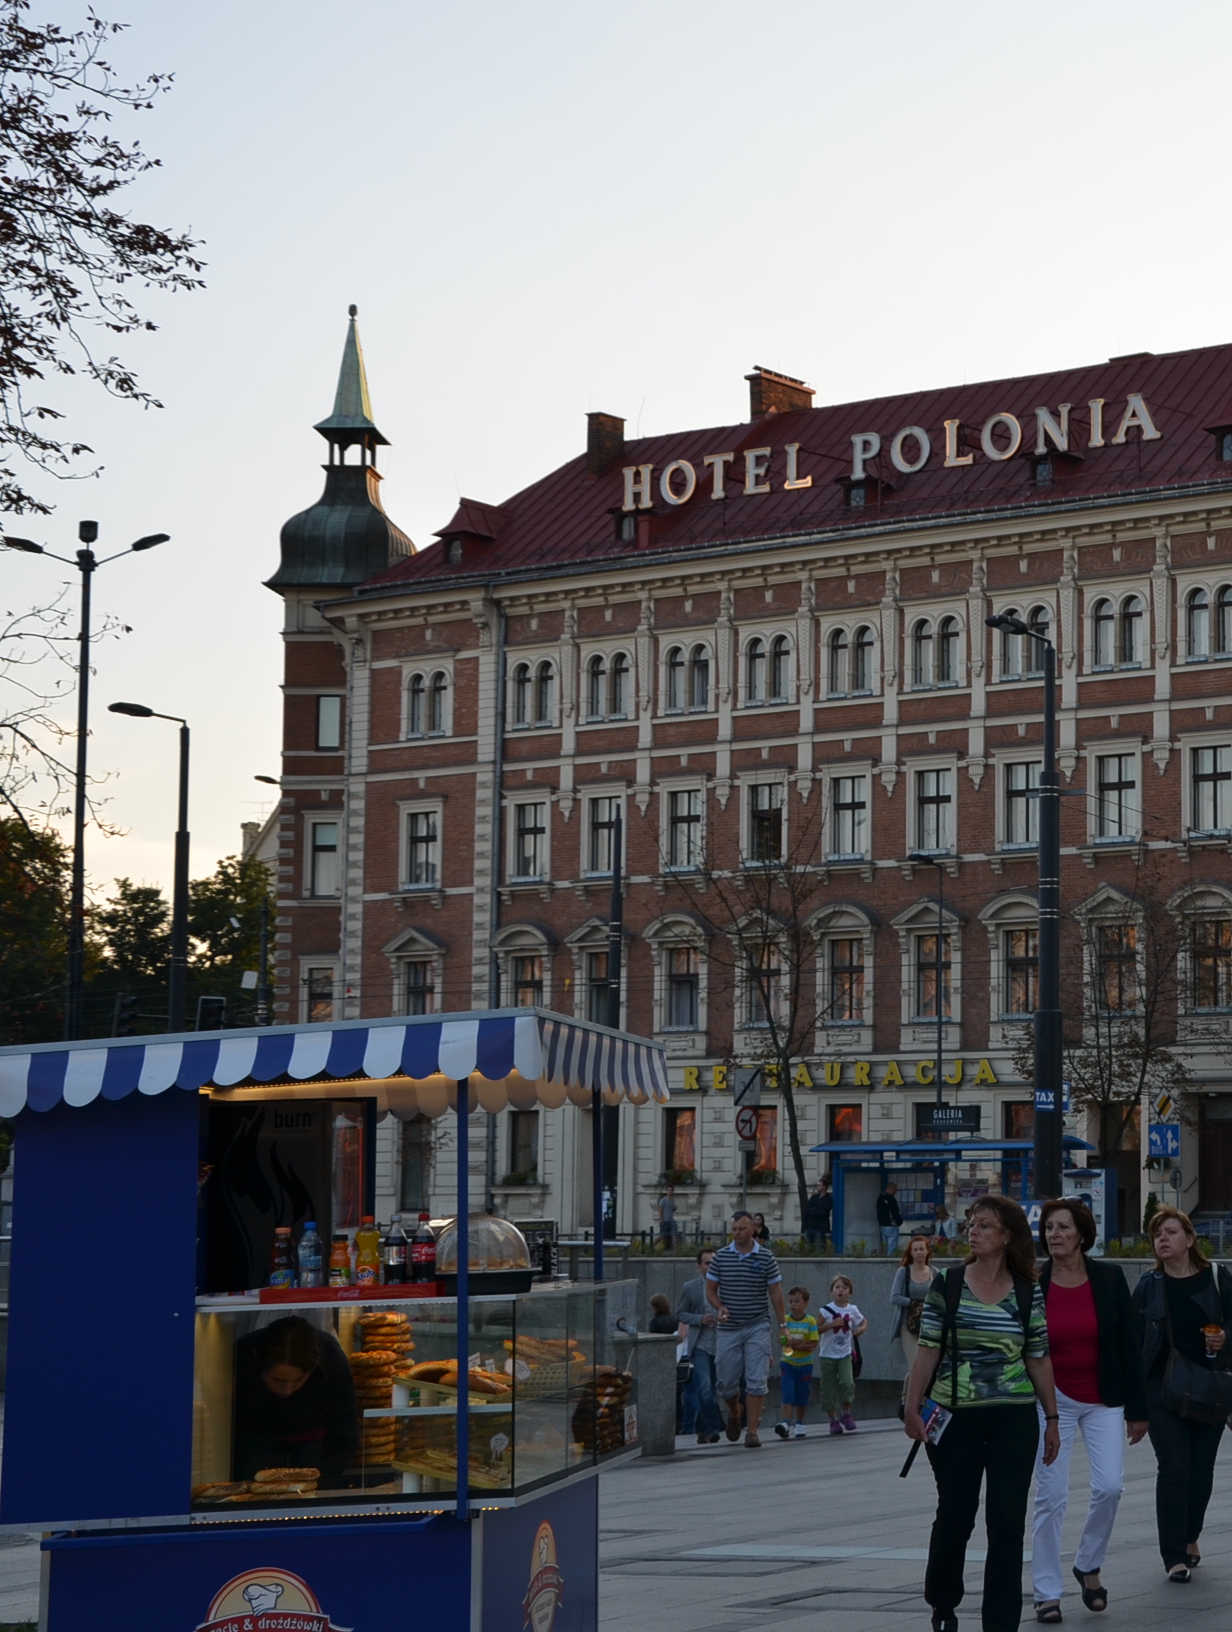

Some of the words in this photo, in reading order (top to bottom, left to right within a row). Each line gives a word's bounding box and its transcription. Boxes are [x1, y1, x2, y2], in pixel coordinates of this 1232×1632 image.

[621, 442, 813, 512] HOTEL
[849, 393, 1162, 482] POLONIA
[683, 1058, 998, 1090] RETAURACJA
[1035, 1091, 1055, 1102] TAX
[274, 1108, 312, 1128] burn
[933, 1109, 963, 1119] GALERIA
[1151, 1145, 1163, 1155] BUS
[337, 1289, 361, 1298] Coca-Cola
[243, 1618, 254, 1631] &
